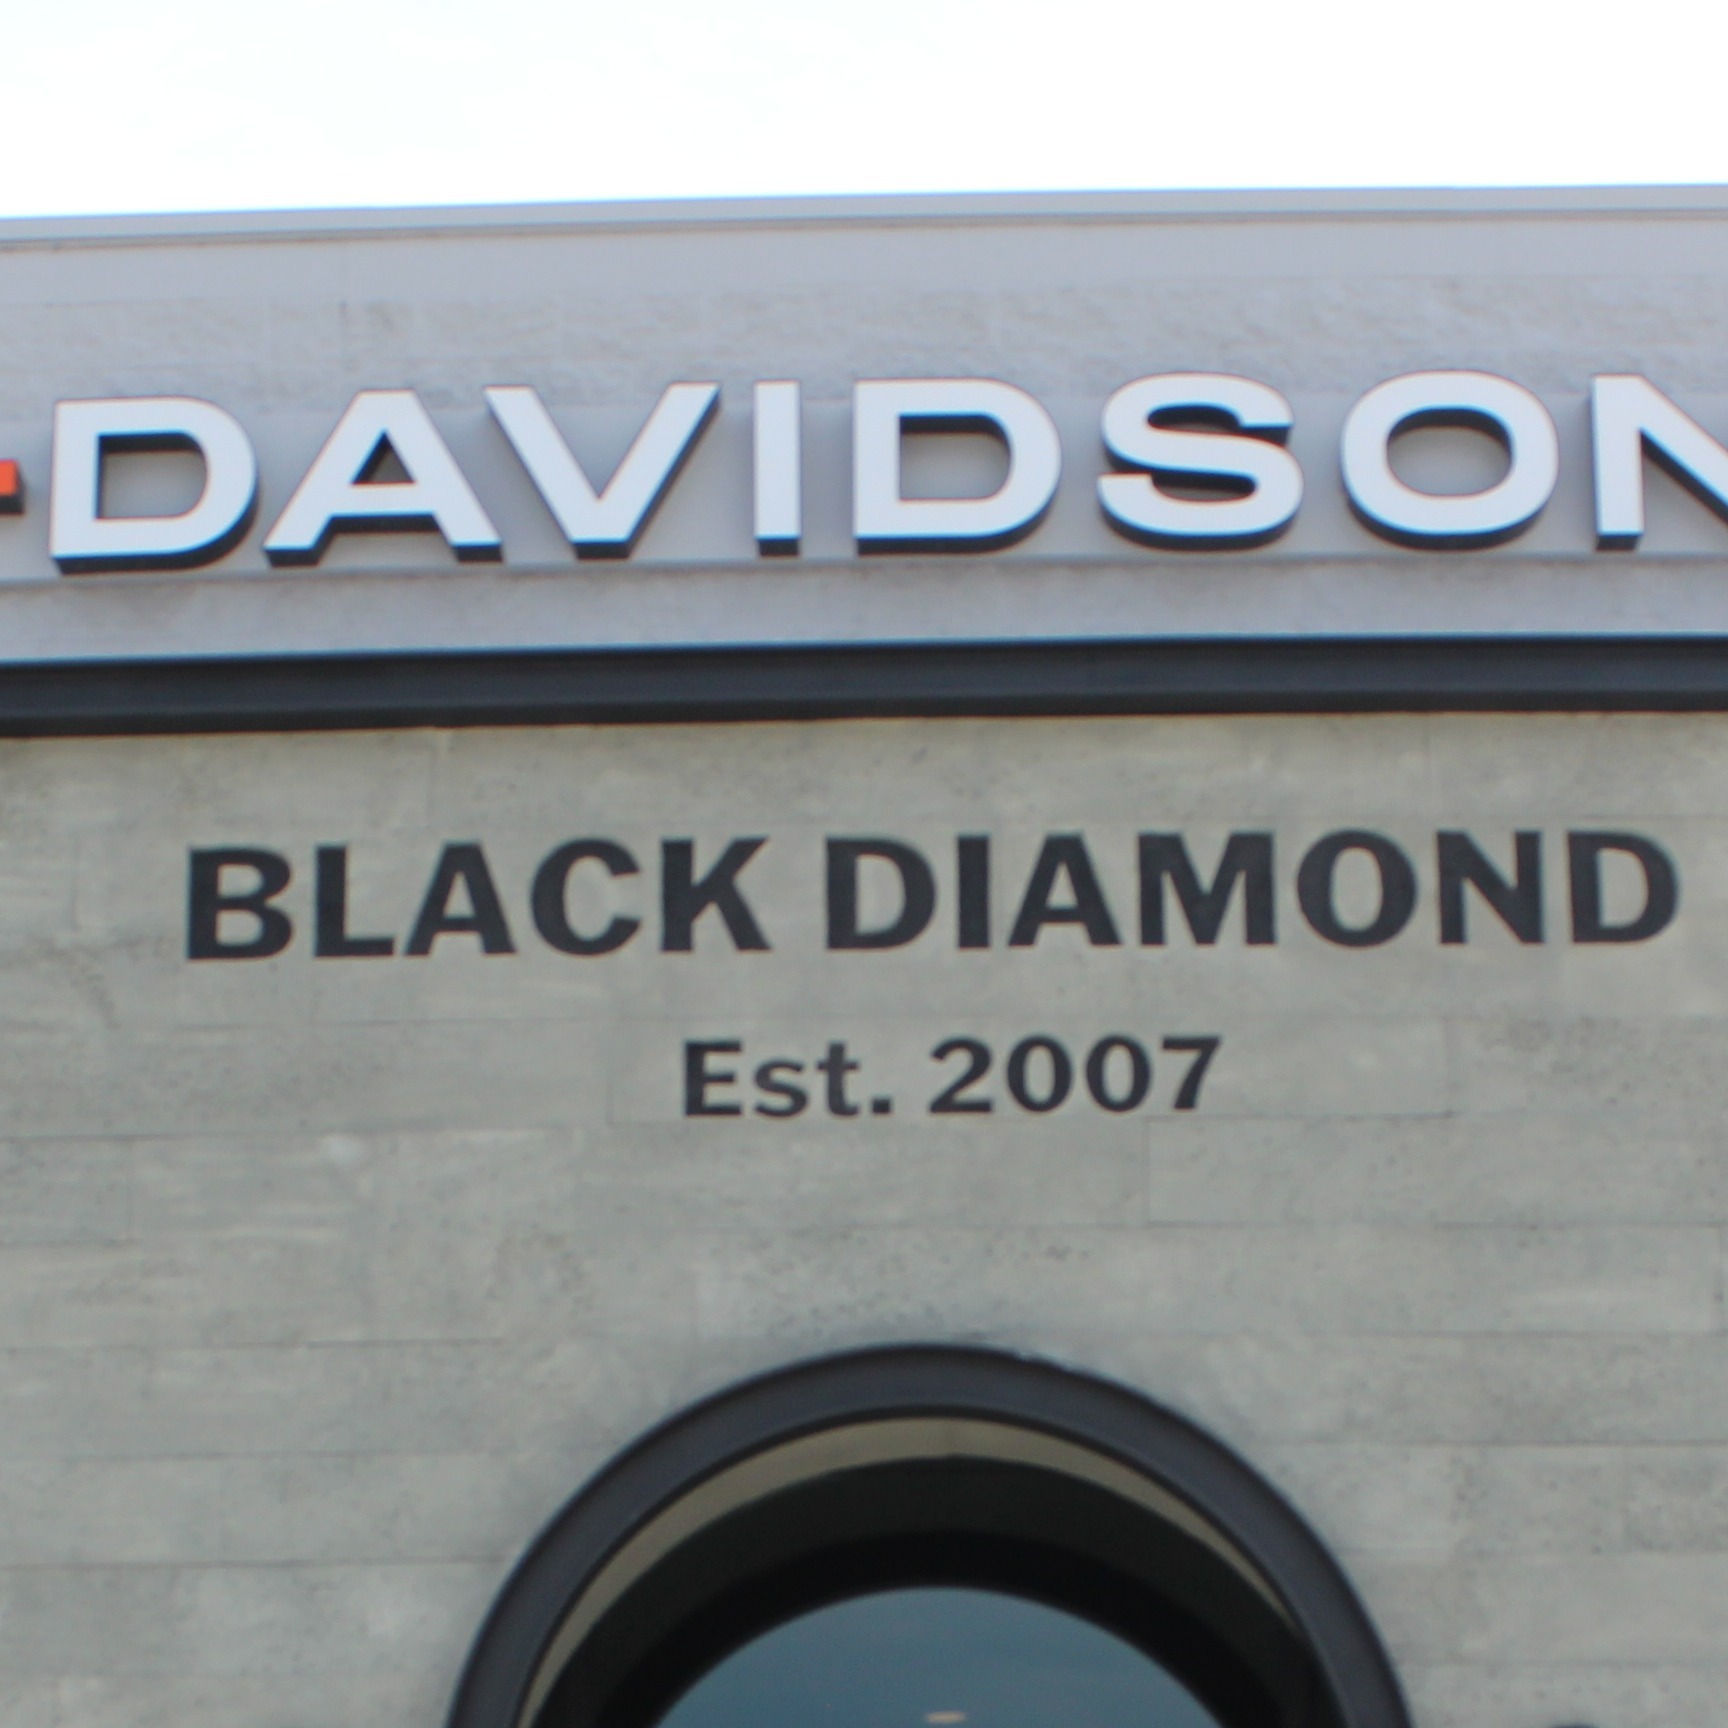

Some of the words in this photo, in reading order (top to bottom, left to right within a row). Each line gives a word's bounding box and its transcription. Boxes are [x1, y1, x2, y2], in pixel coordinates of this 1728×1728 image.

[185, 836, 771, 961] BLACK
[825, 829, 1680, 951] DIAMOND
[683, 1039, 892, 1118] Est.
[928, 1034, 1221, 1115] 2007
